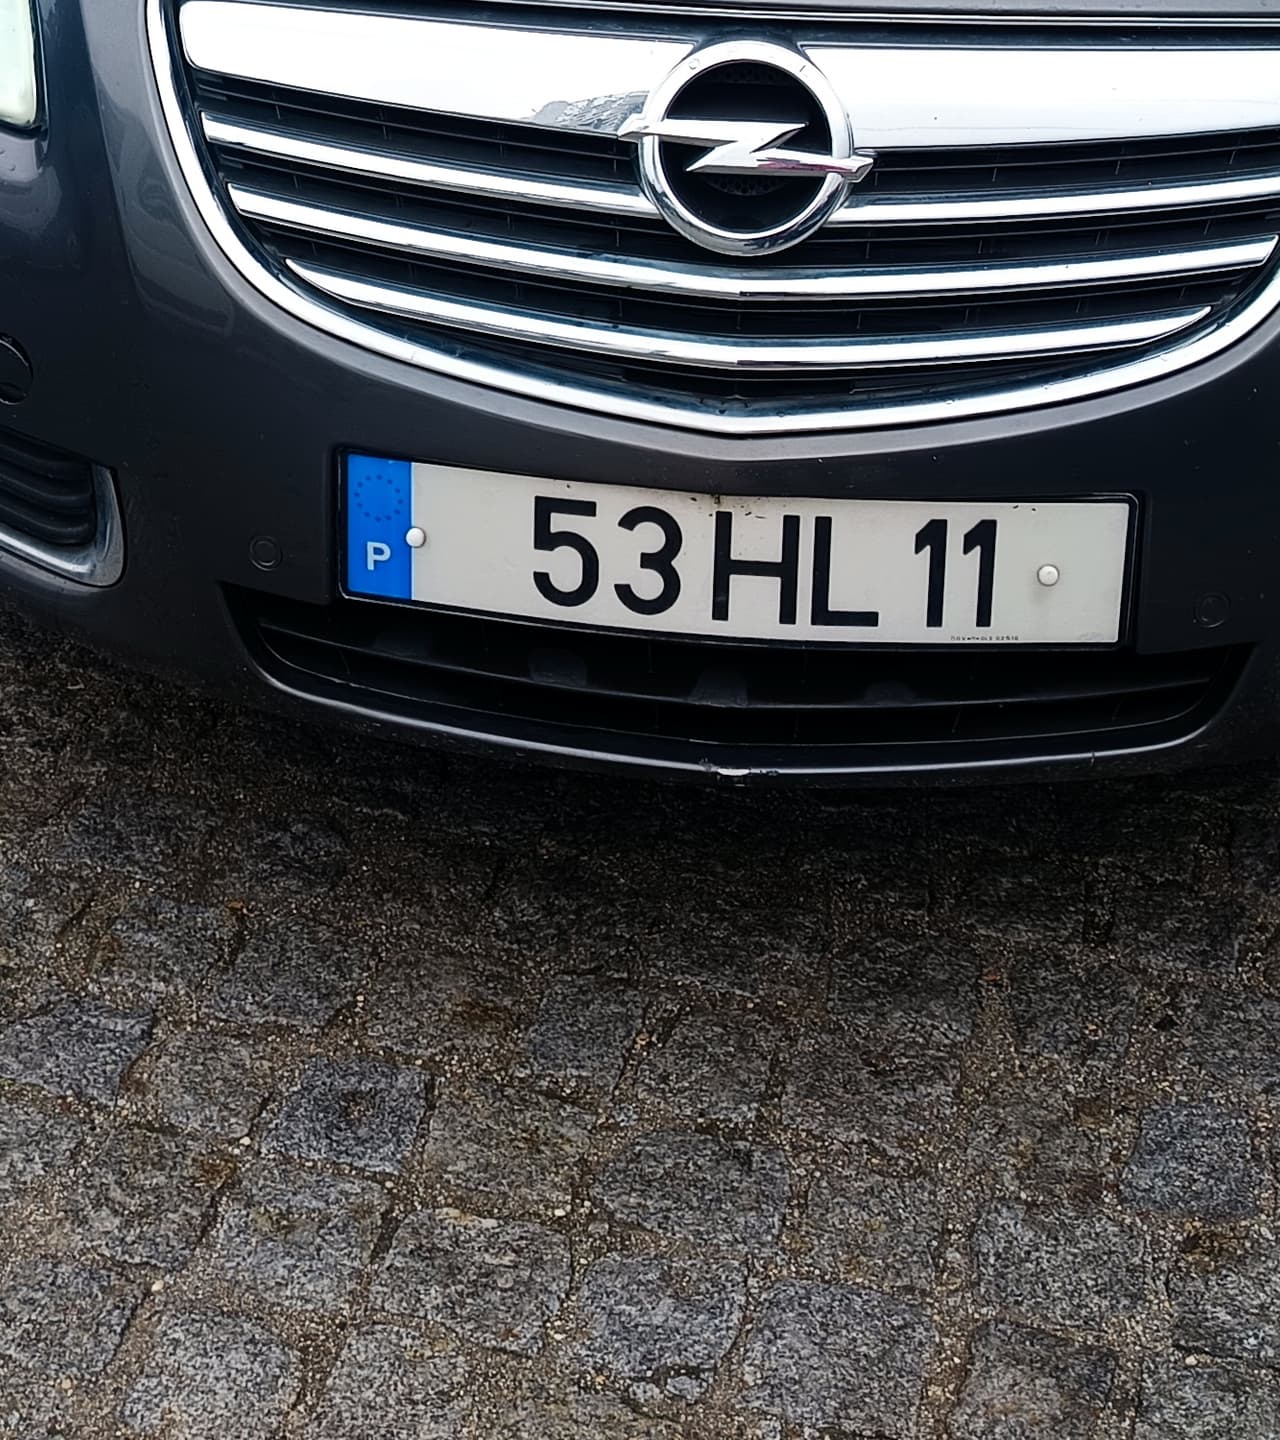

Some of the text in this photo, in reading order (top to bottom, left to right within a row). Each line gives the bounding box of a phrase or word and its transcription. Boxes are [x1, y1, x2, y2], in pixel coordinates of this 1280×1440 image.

[366, 495, 998, 628] P 53 HL 11
